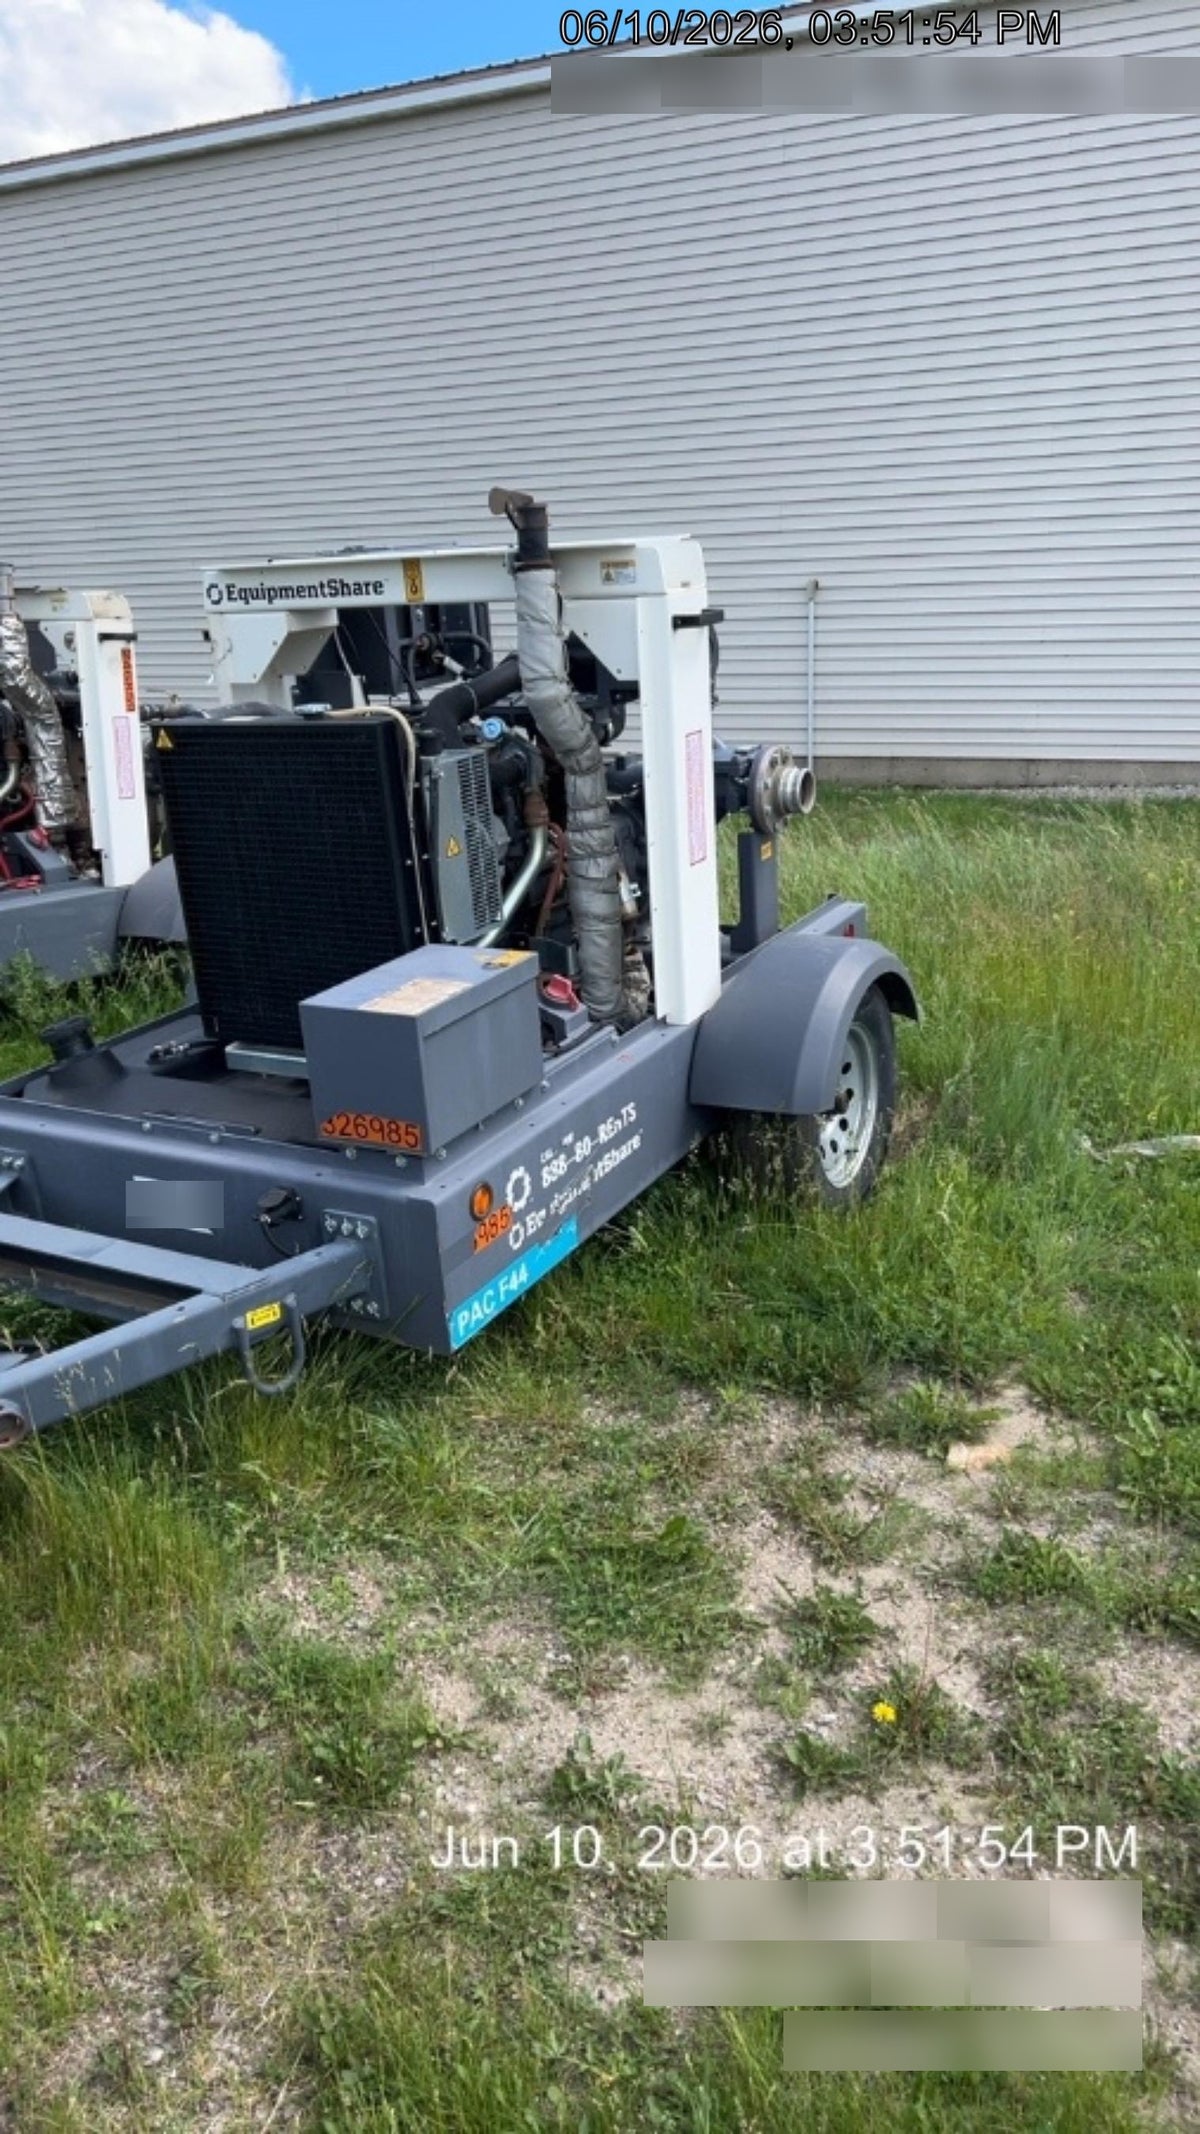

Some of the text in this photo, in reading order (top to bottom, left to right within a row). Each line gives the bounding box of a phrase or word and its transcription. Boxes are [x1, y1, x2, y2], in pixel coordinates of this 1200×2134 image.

[225, 578, 385, 605] EquipmentShare
[322, 1112, 419, 1149] 326985
[457, 1261, 529, 1337] PAC F44
